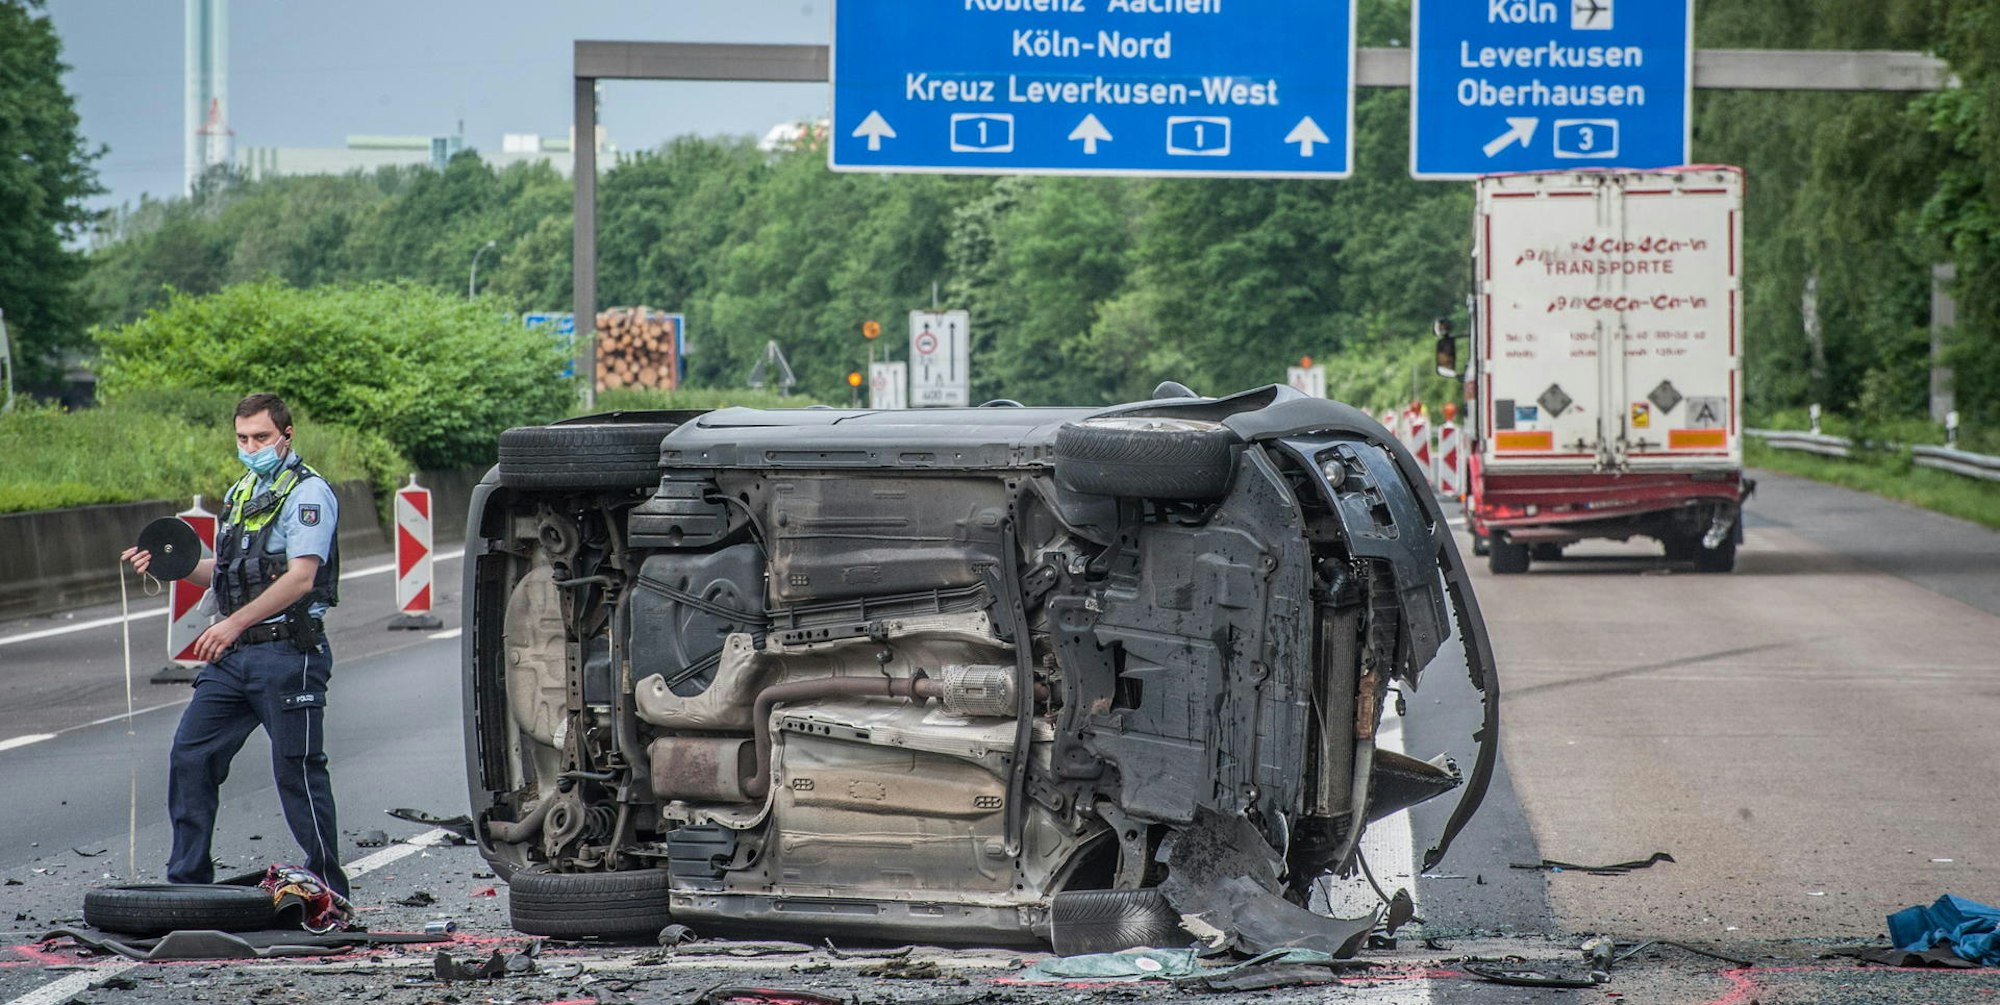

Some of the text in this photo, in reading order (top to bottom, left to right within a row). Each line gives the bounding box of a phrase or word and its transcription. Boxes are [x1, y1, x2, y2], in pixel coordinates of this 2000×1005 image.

[1488, 0, 1557, 23] Köln
[1012, 29, 1171, 59] Köln-Nord
[1460, 40, 1643, 68] Leverkusen
[906, 72, 1280, 106] Kreuz Leverkusen-West
[1457, 78, 1645, 106] Oberhausen
[977, 121, 987, 145] 1
[1194, 124, 1204, 148] 1
[1578, 127, 1594, 150] 3
[1546, 259, 1674, 276] TRANSPORTE
[1695, 402, 1716, 422] A
